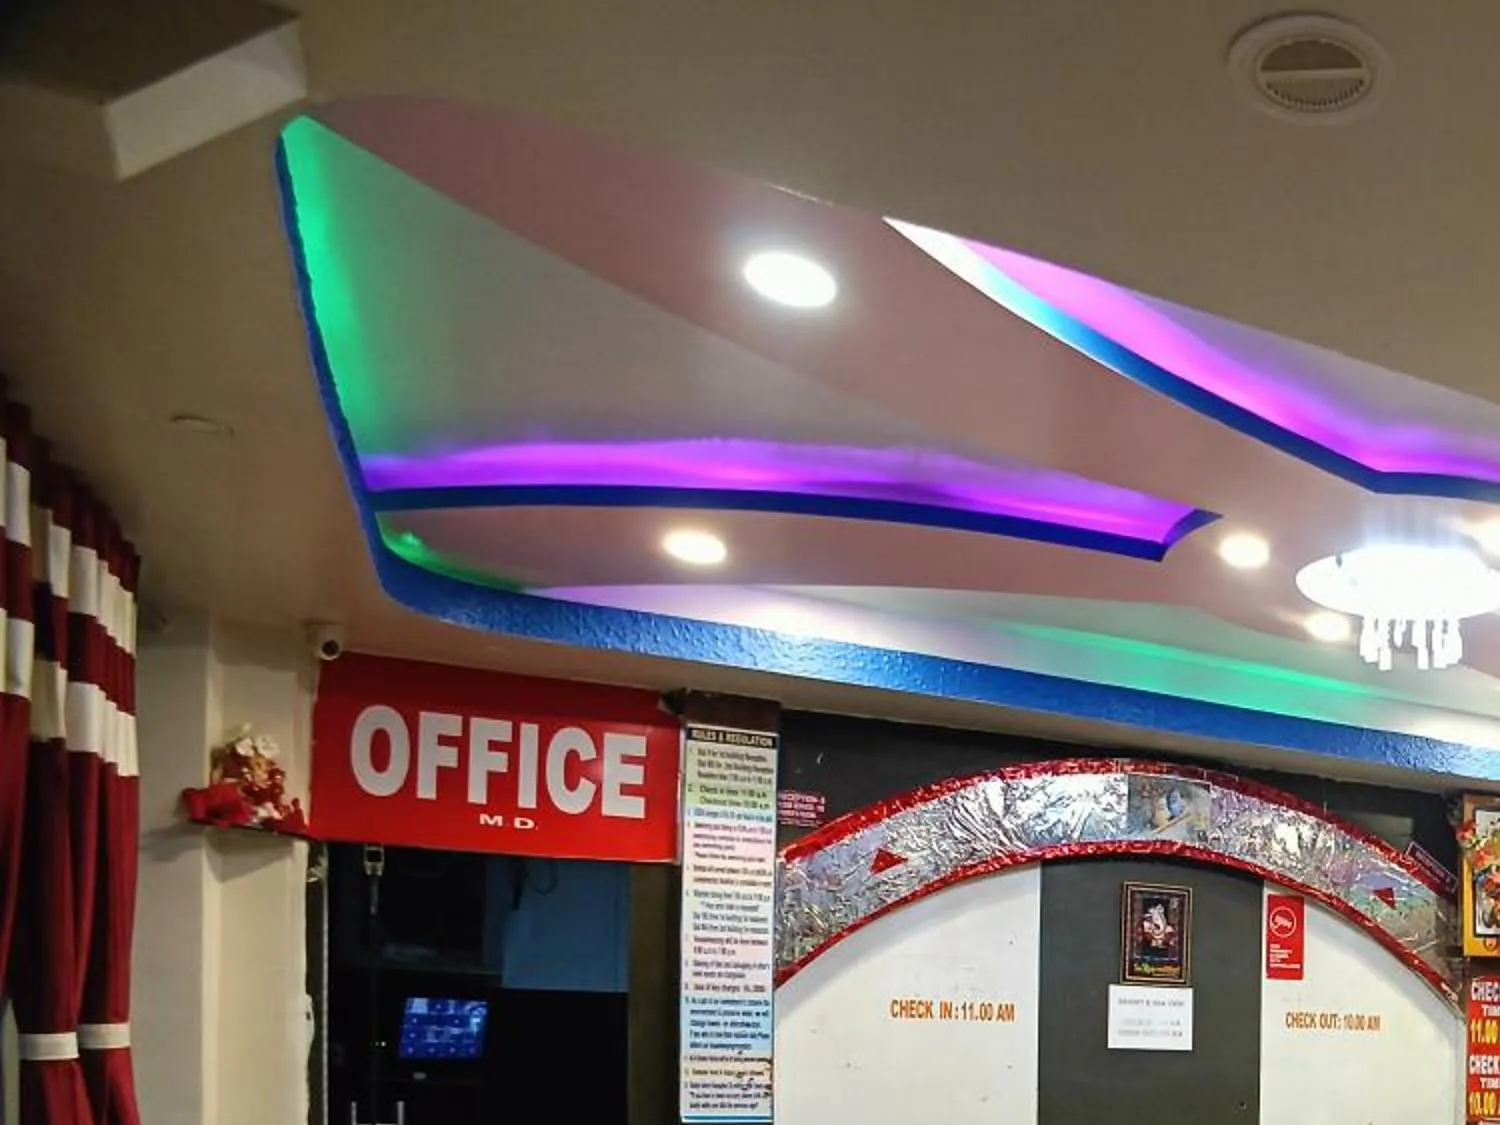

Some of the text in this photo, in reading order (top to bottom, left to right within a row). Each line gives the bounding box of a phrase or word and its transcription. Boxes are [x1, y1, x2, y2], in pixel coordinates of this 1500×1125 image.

[351, 704, 647, 819] OFFICE
[890, 999, 934, 1019] CHECK
[996, 1003, 1015, 1022] AM
[1285, 1011, 1317, 1029] CHECK
[1469, 1054, 1500, 1075] CHECK
